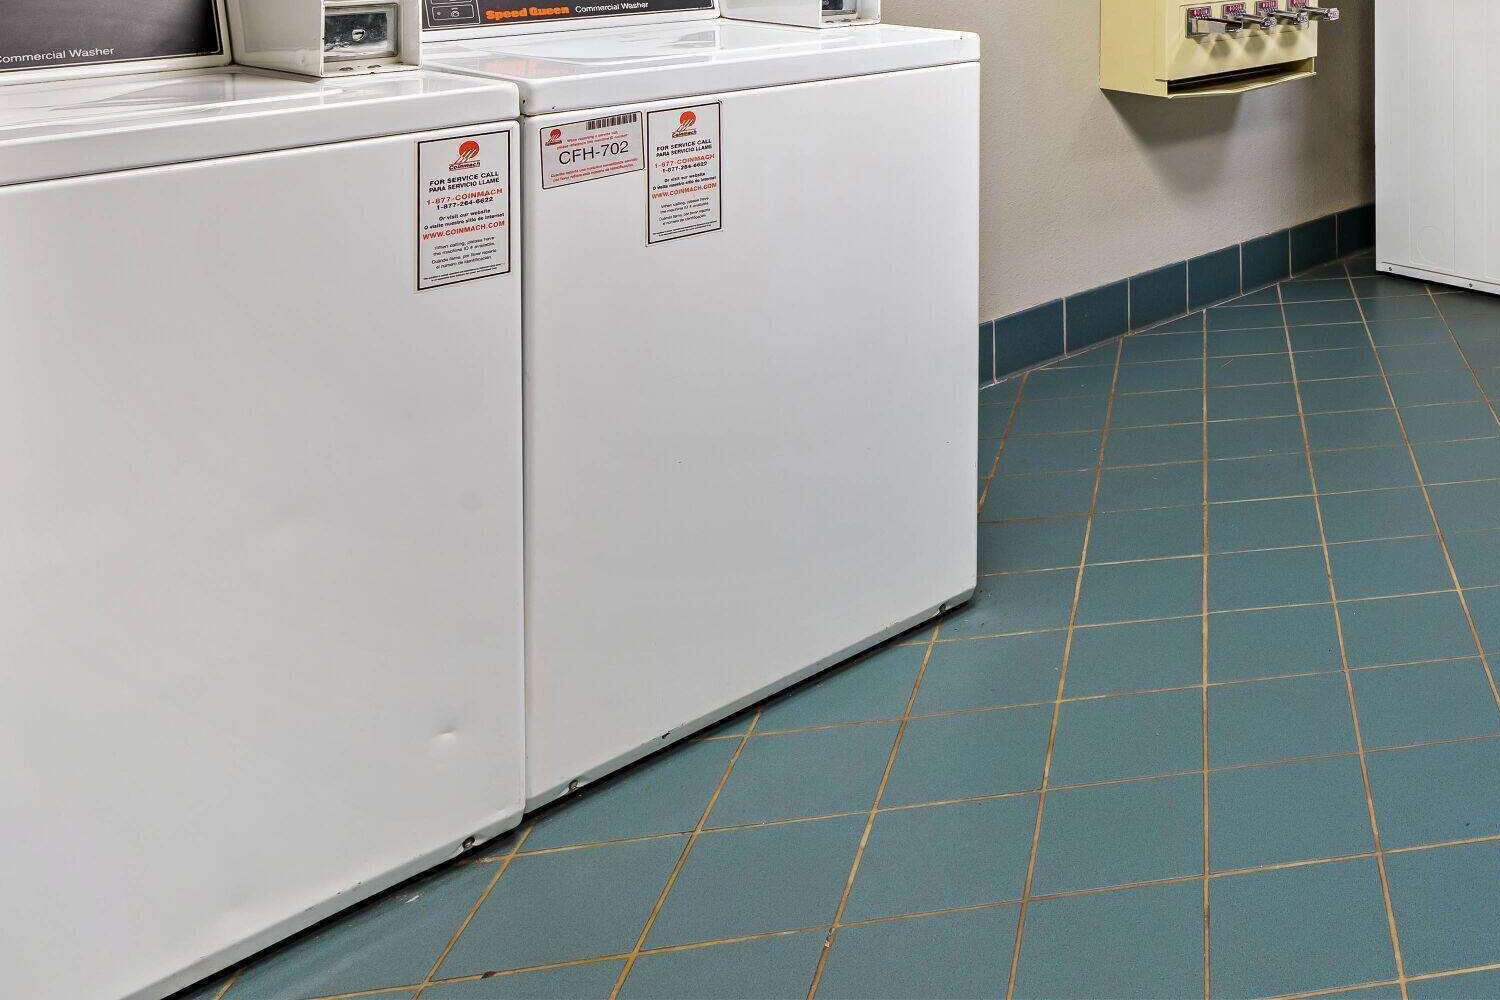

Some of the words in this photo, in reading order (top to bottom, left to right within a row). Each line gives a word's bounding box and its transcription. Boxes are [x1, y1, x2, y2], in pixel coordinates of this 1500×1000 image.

[485, 7, 528, 20] Speed
[529, 6, 569, 17] Queen
[575, 2, 620, 13] Commercial
[621, 1, 649, 10] Washer
[0, 50, 65, 63] ommercial
[69, 47, 114, 59] Washer
[559, 141, 629, 164] CFH-702
[448, 160, 480, 171] Coinmach
[447, 174, 478, 184] SERVICE
[448, 181, 477, 190] SERVICIO
[426, 188, 503, 206] 1-877-COINMACH
[651, 182, 717, 200] WWW.COINMACH.COM
[436, 197, 493, 210] 1-877-264-6622
[422, 220, 505, 240] WWW.COINMACH.COM
